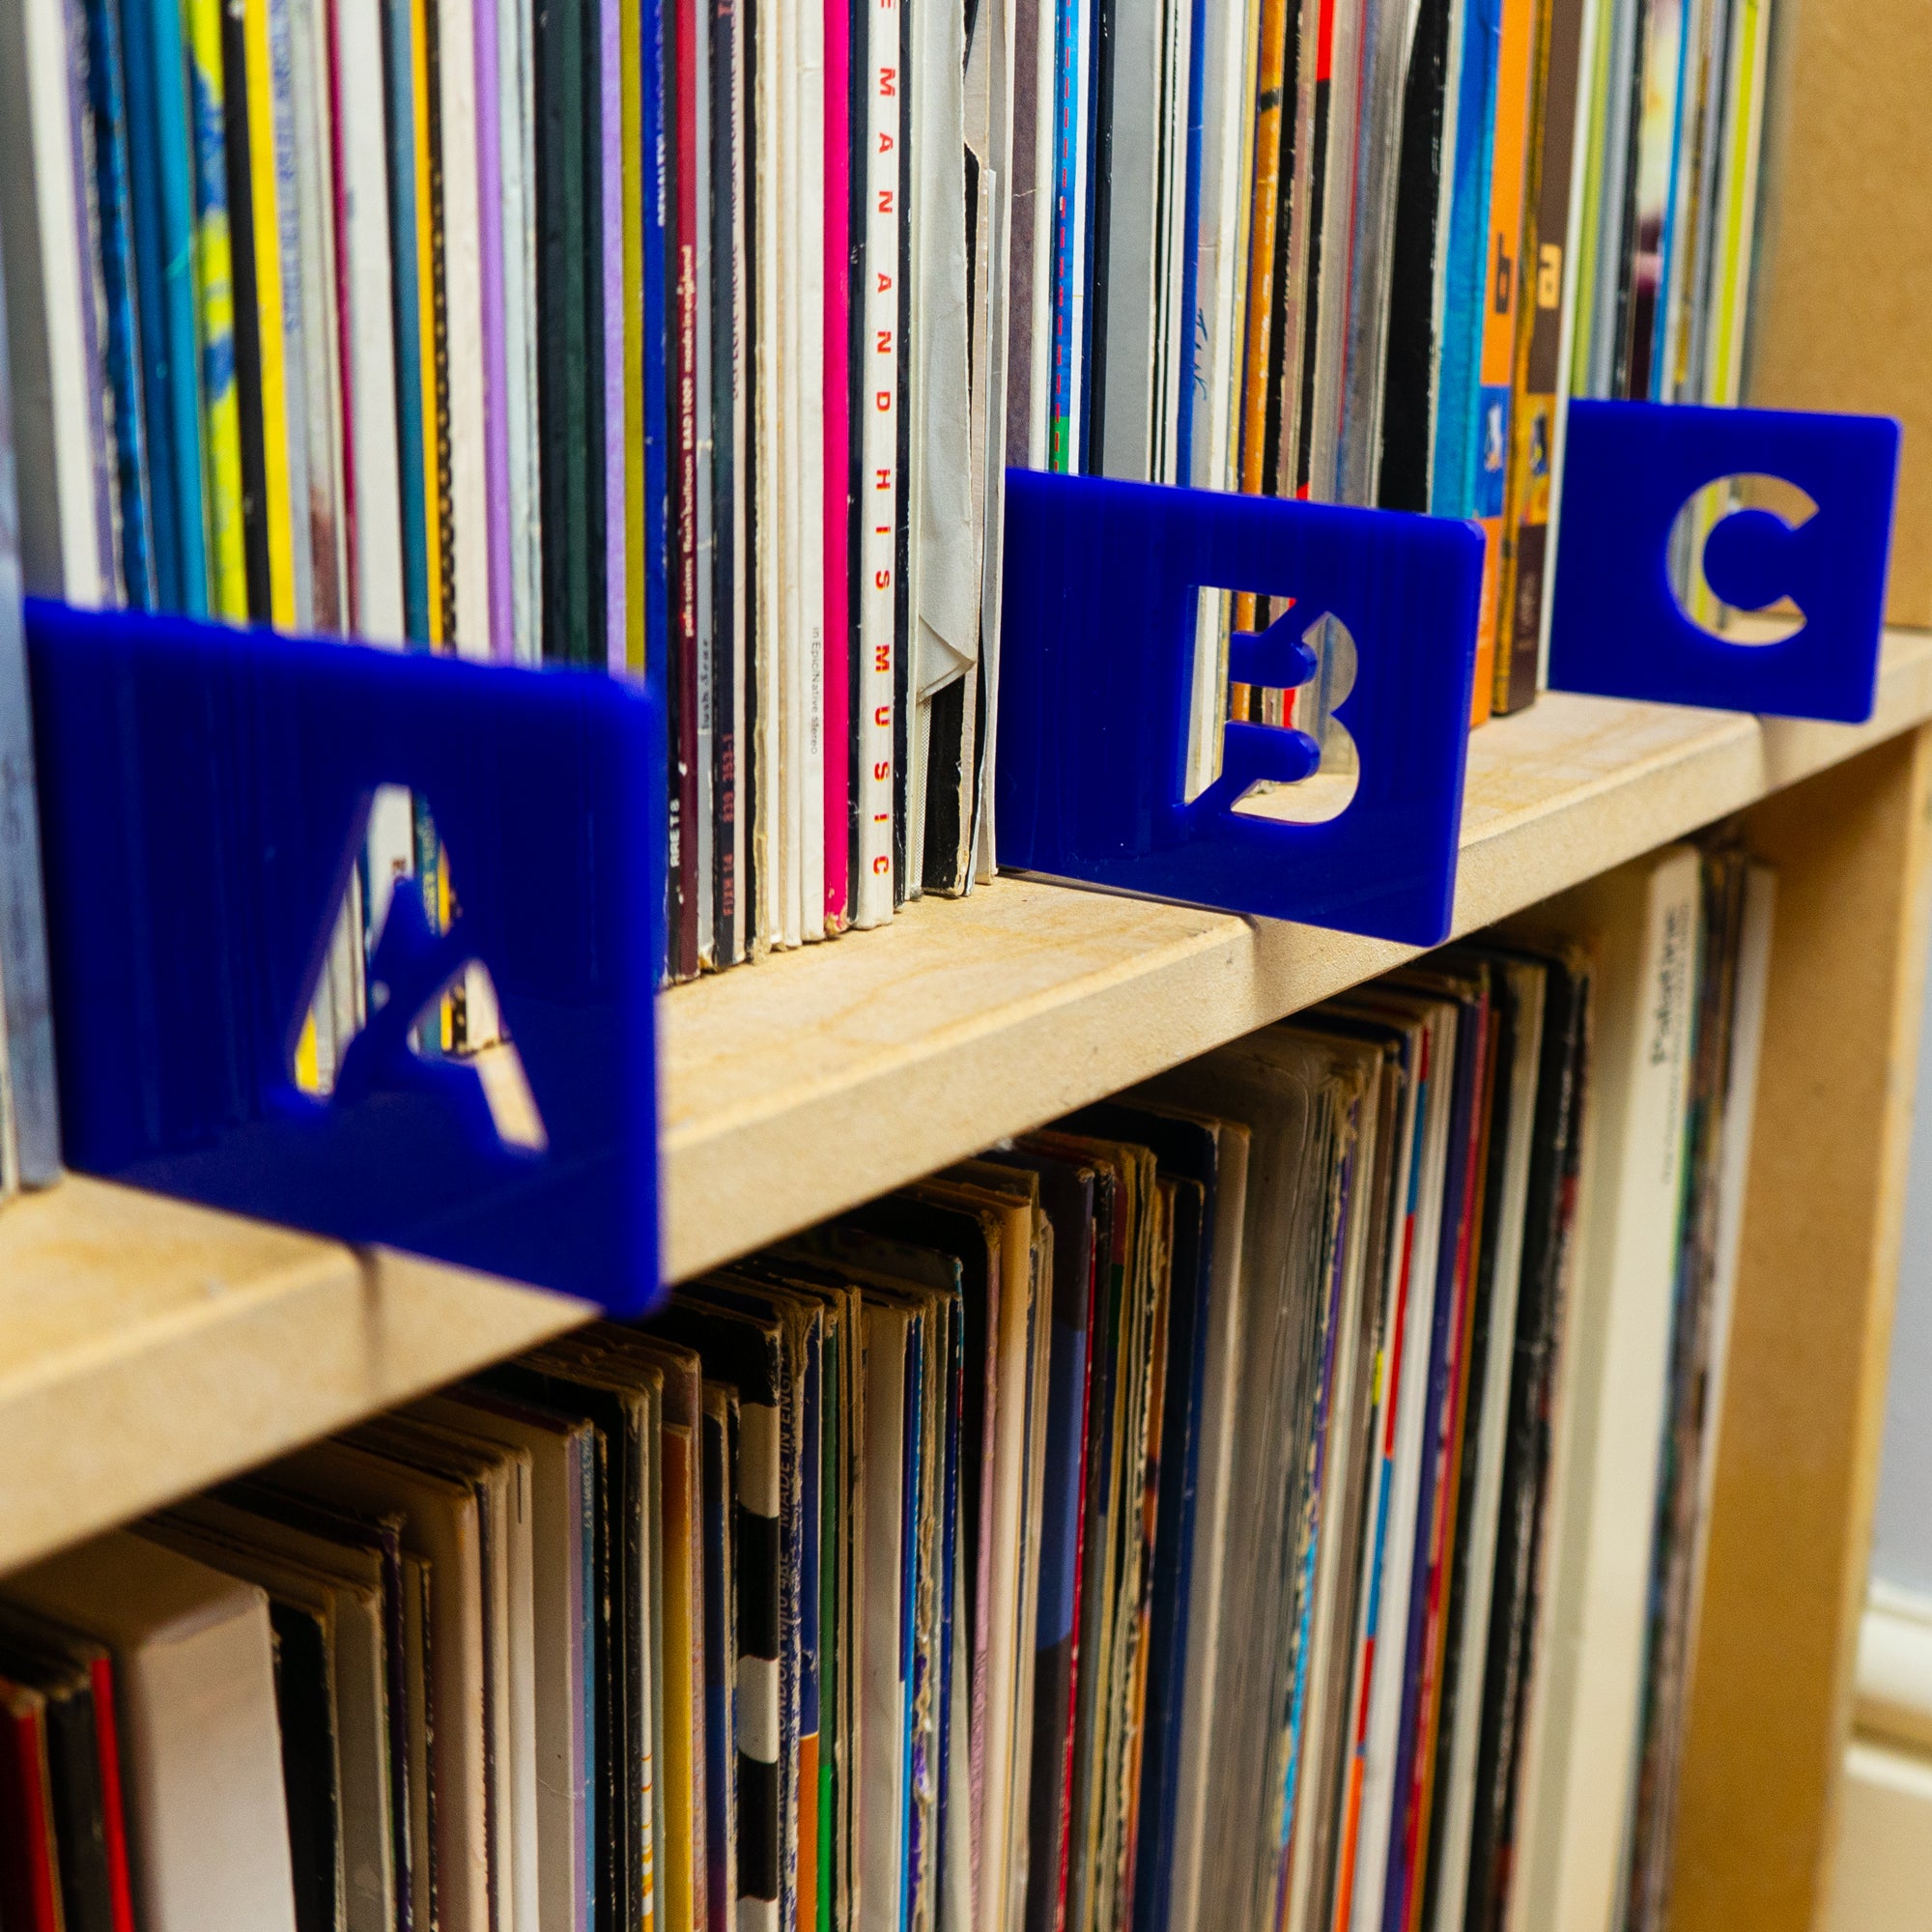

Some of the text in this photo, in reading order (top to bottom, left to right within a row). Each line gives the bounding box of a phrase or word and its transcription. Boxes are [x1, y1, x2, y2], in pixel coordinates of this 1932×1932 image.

[872, 67, 895, 876] MAN AND HIS MUSIC
[1666, 471, 1821, 647] C
[810, 717, 819, 755] stereo
[1182, 584, 1360, 824] B
[291, 784, 549, 1152] A
